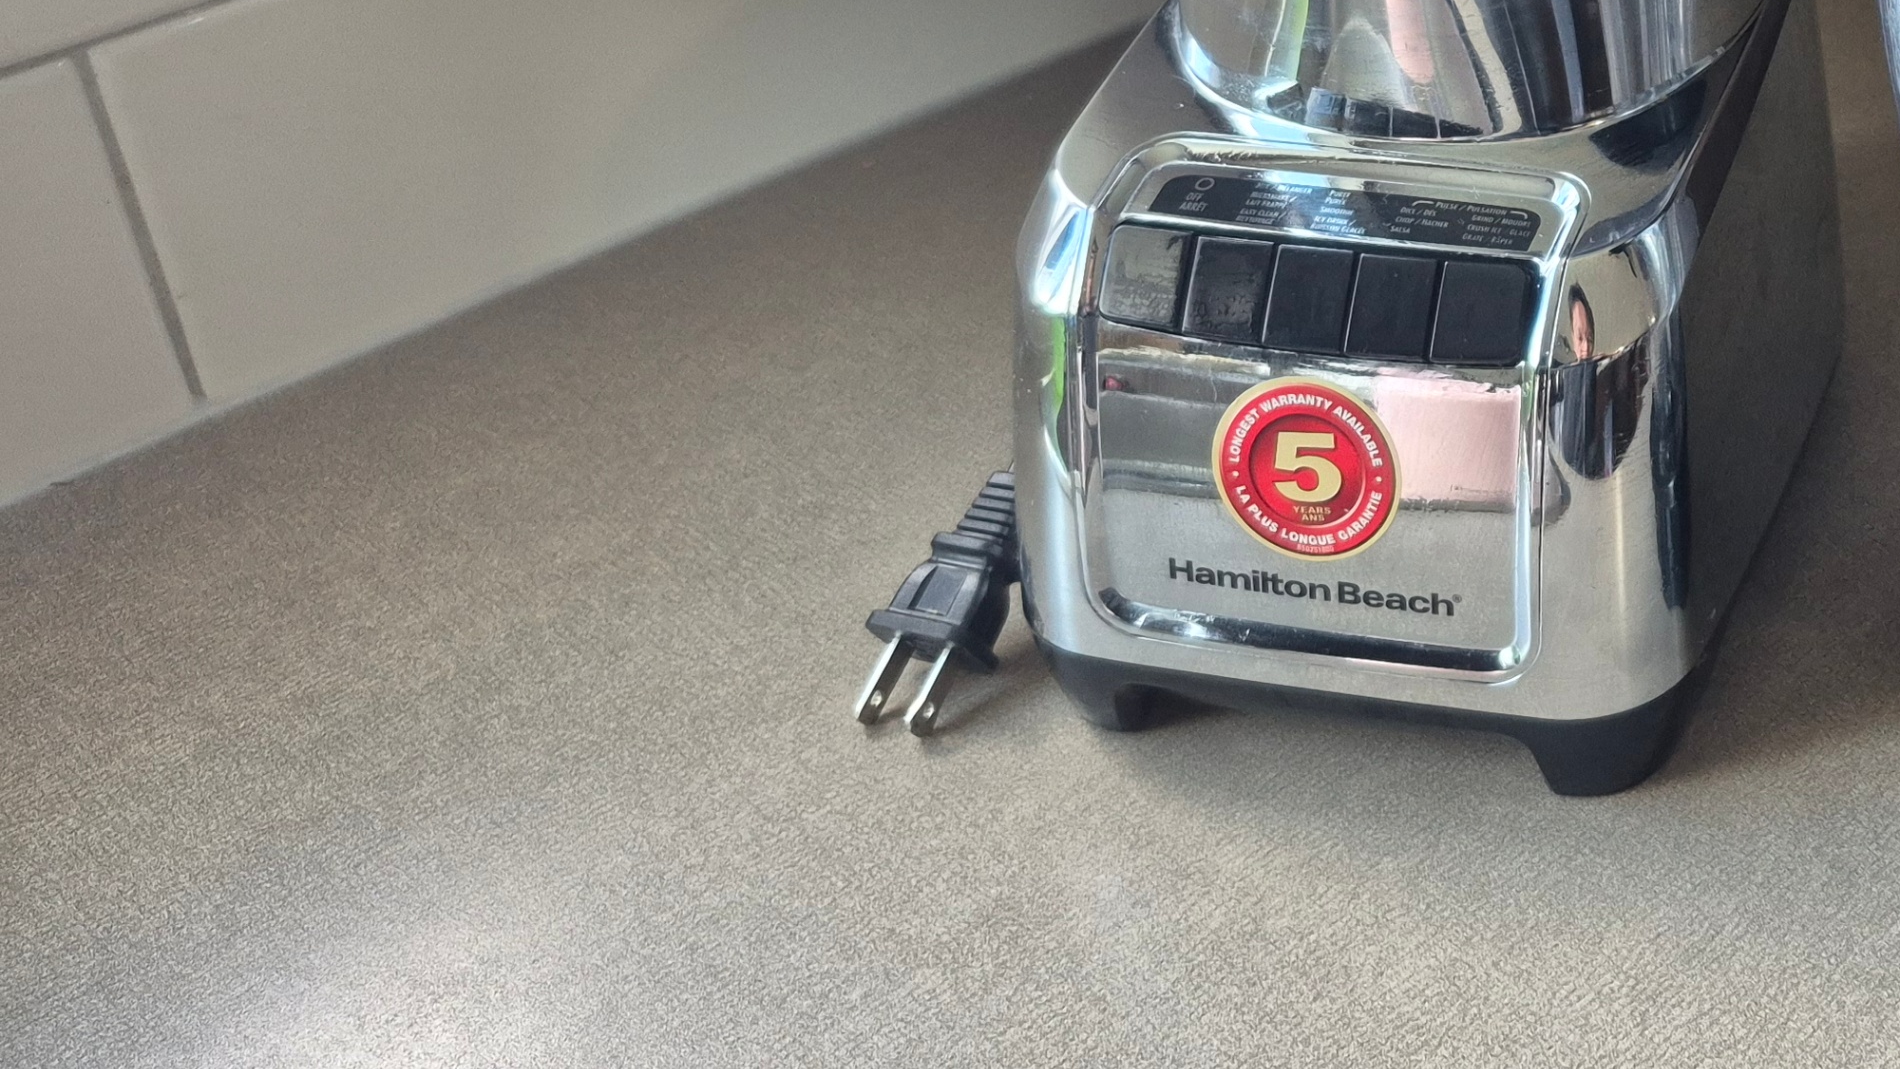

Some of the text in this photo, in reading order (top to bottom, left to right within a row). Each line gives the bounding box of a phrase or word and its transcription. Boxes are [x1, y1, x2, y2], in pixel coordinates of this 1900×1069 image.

[1186, 192, 1205, 201] OFF
[1435, 201, 1460, 210] PULSE
[1466, 204, 1508, 215] PULSATION
[1471, 214, 1495, 223] GRIND
[1390, 225, 1411, 234] SALSA
[1467, 223, 1490, 232] CRUSH
[1490, 225, 1502, 234] ICE
[1462, 232, 1484, 242] GRATE
[1229, 393, 1383, 467] LONGEST WARRANTY AVAILABLE
[1272, 431, 1343, 503] 5
[1235, 484, 1383, 546] LA PLUS LONGUE GARANTIE
[1292, 505, 1332, 516] YEARS
[1301, 513, 1326, 523] ANS
[1168, 557, 1332, 602] Hamilton
